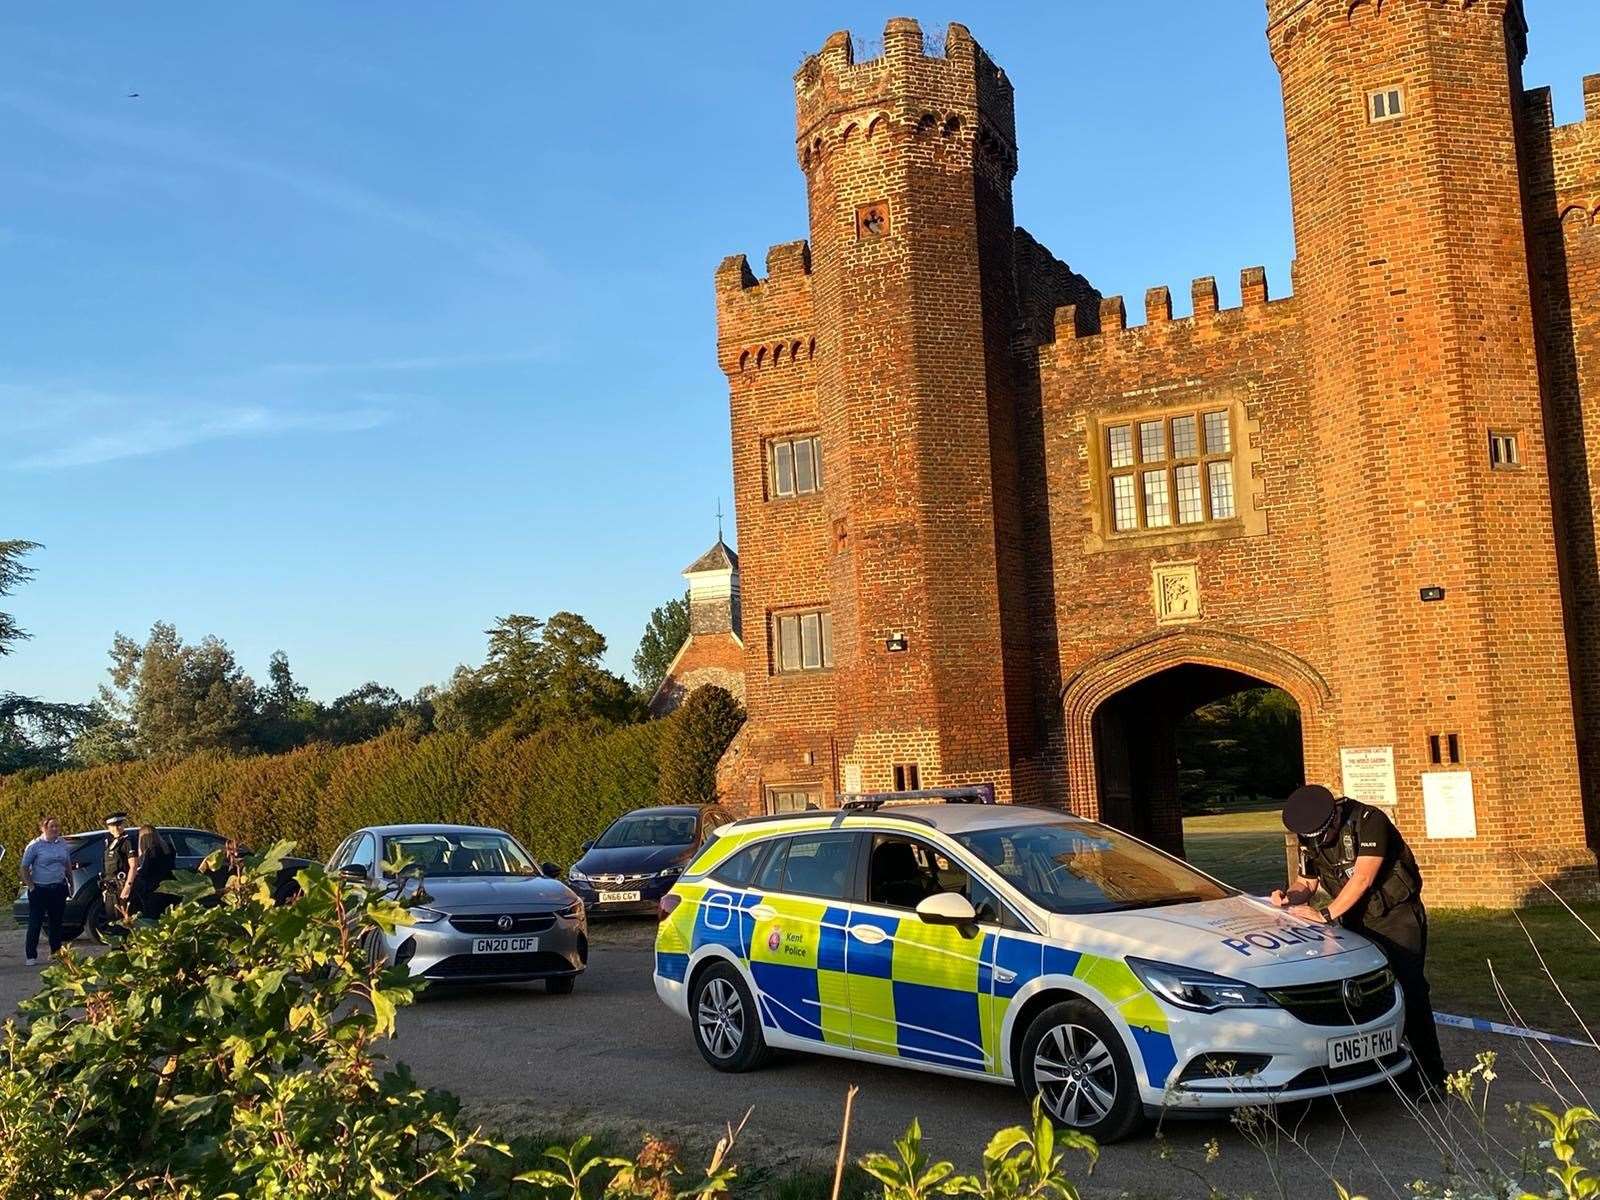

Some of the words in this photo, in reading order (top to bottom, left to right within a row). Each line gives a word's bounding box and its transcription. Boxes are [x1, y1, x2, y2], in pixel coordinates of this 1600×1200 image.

[786, 932, 804, 943] Kent
[477, 939, 509, 952] GN20
[511, 938, 534, 951] CDF
[784, 945, 807, 957] Police
[1334, 1034, 1369, 1063] GN67
[1371, 1029, 1393, 1056] FKH
